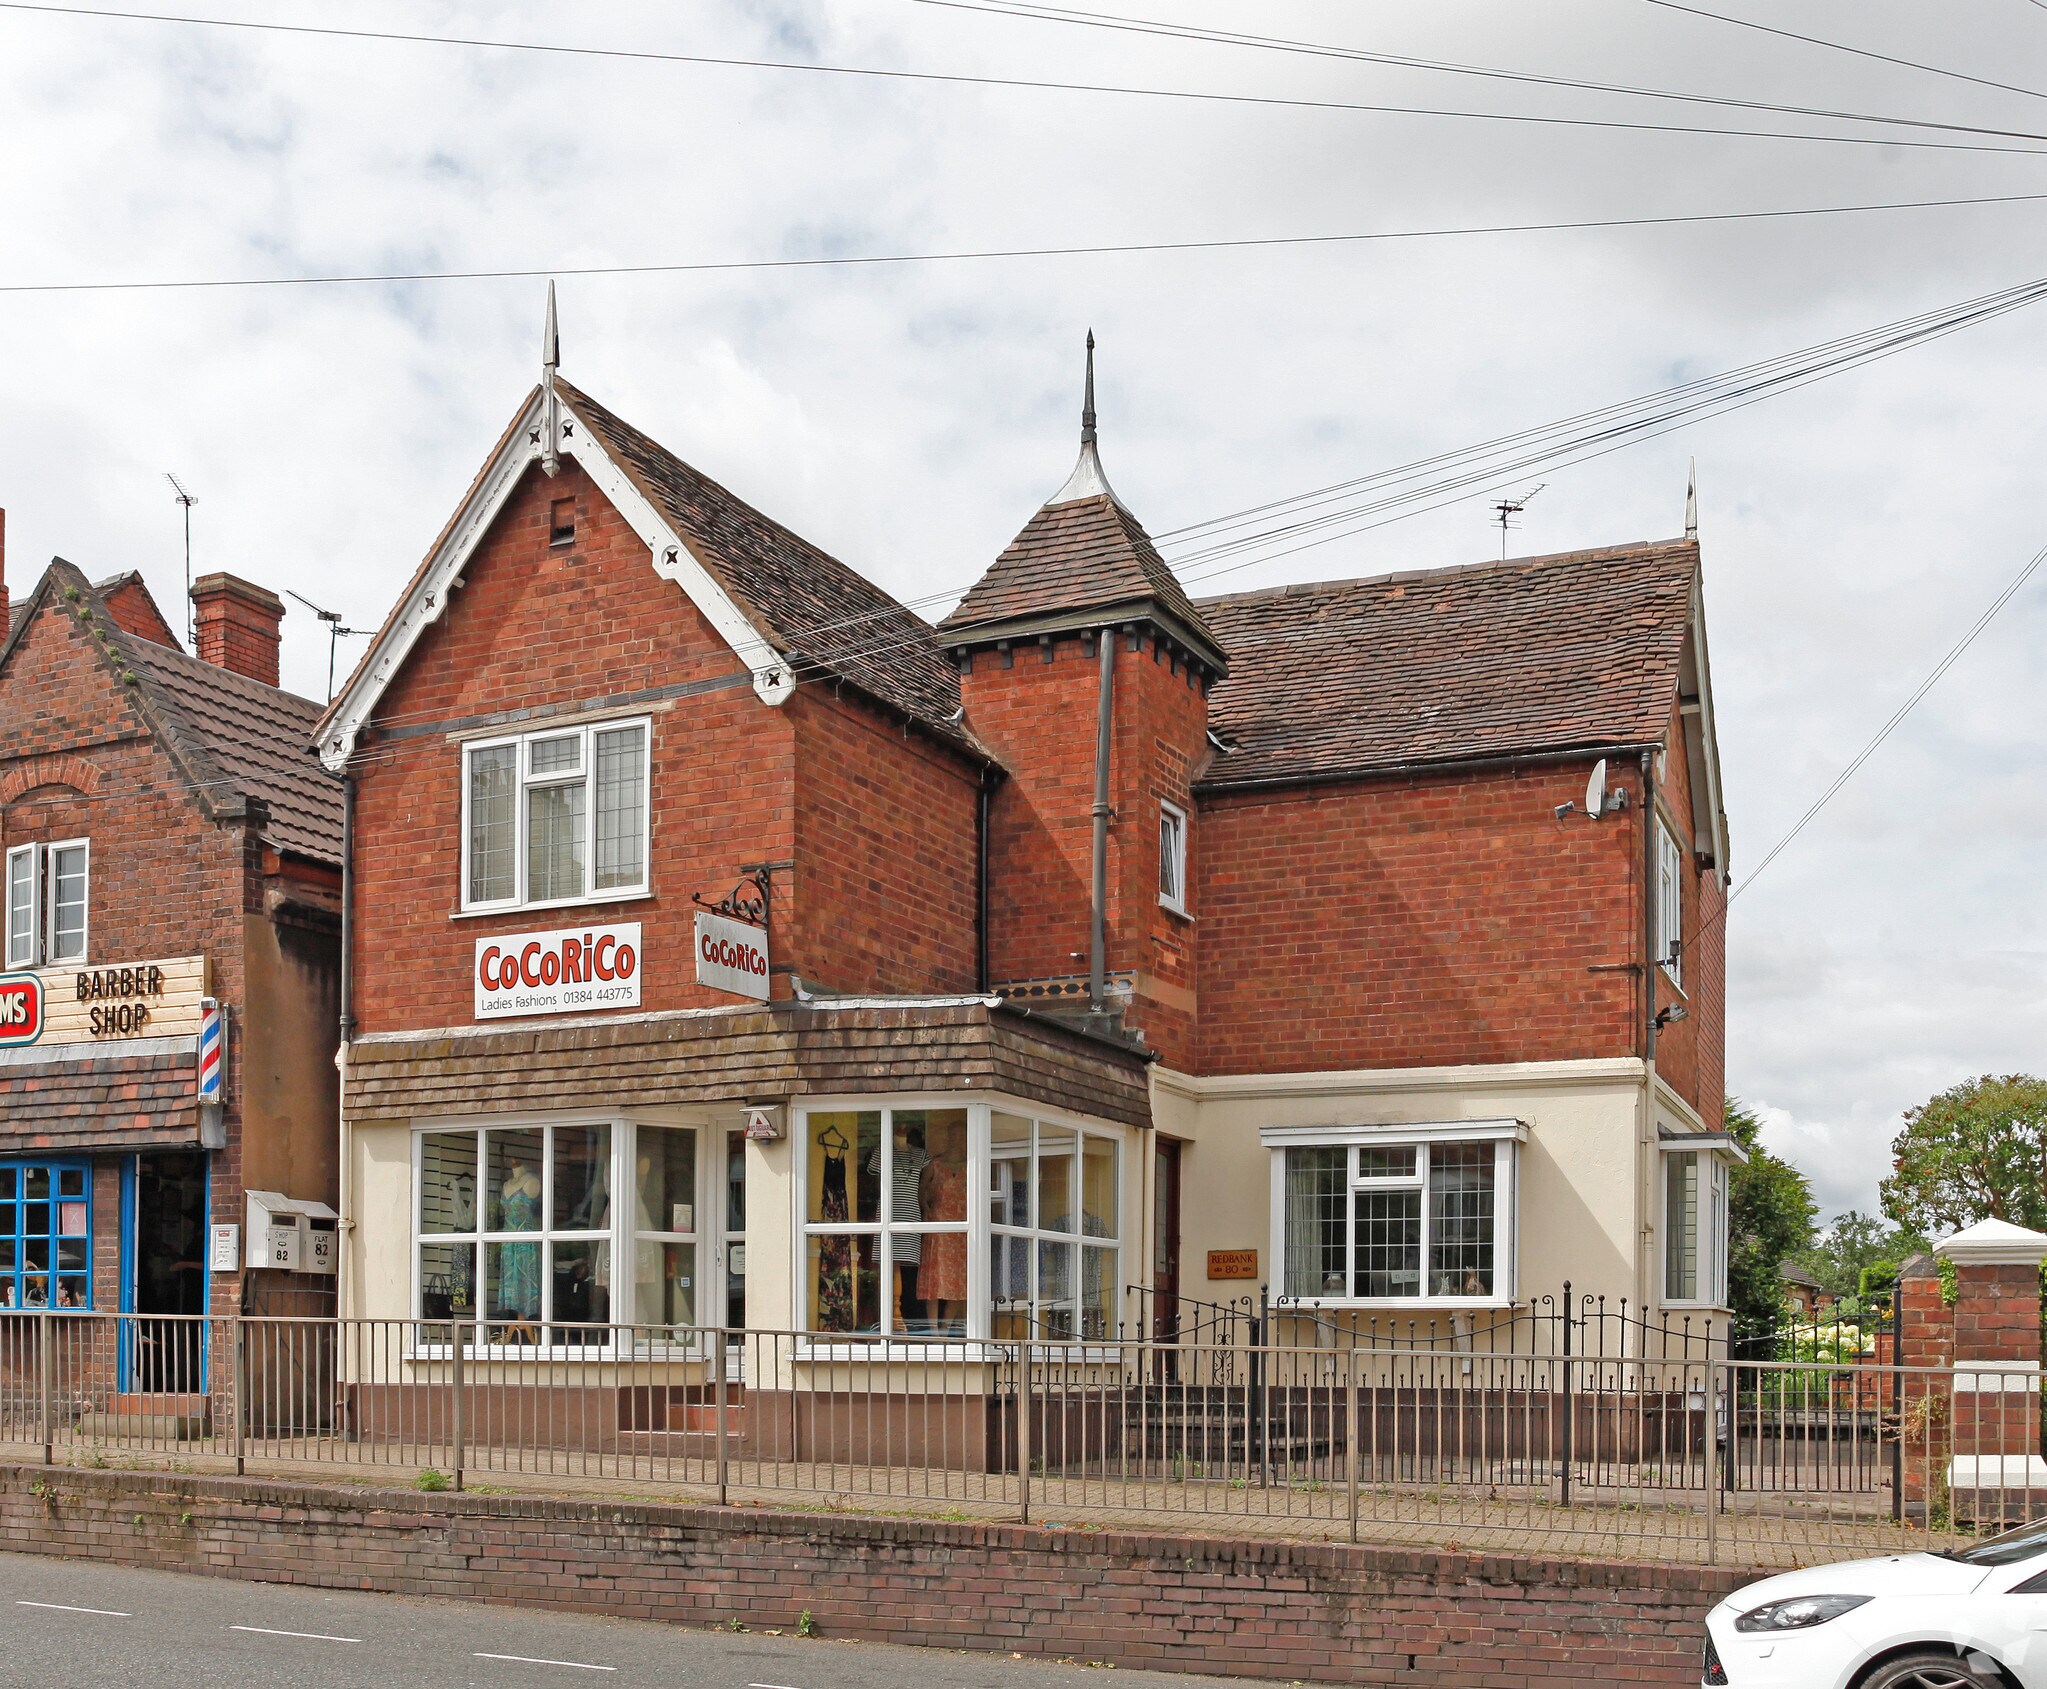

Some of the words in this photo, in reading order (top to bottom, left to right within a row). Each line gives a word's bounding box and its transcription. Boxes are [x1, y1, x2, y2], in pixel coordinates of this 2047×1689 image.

[480, 933, 635, 991] CoCoRiCo
[701, 934, 766, 976] CoCoRiCo
[76, 965, 160, 999] BARBER
[481, 996, 513, 1011] Ladies
[515, 993, 557, 1009] Fashions
[563, 990, 593, 1004] 01384
[596, 986, 633, 1000] 443775
[90, 1003, 146, 1035] SHOP
[275, 1231, 288, 1239] SHOP
[276, 1250, 288, 1261] 82
[315, 1243, 328, 1256] 82
[1211, 1255, 1253, 1263] REDBANK
[1225, 1265, 1239, 1274] 80
